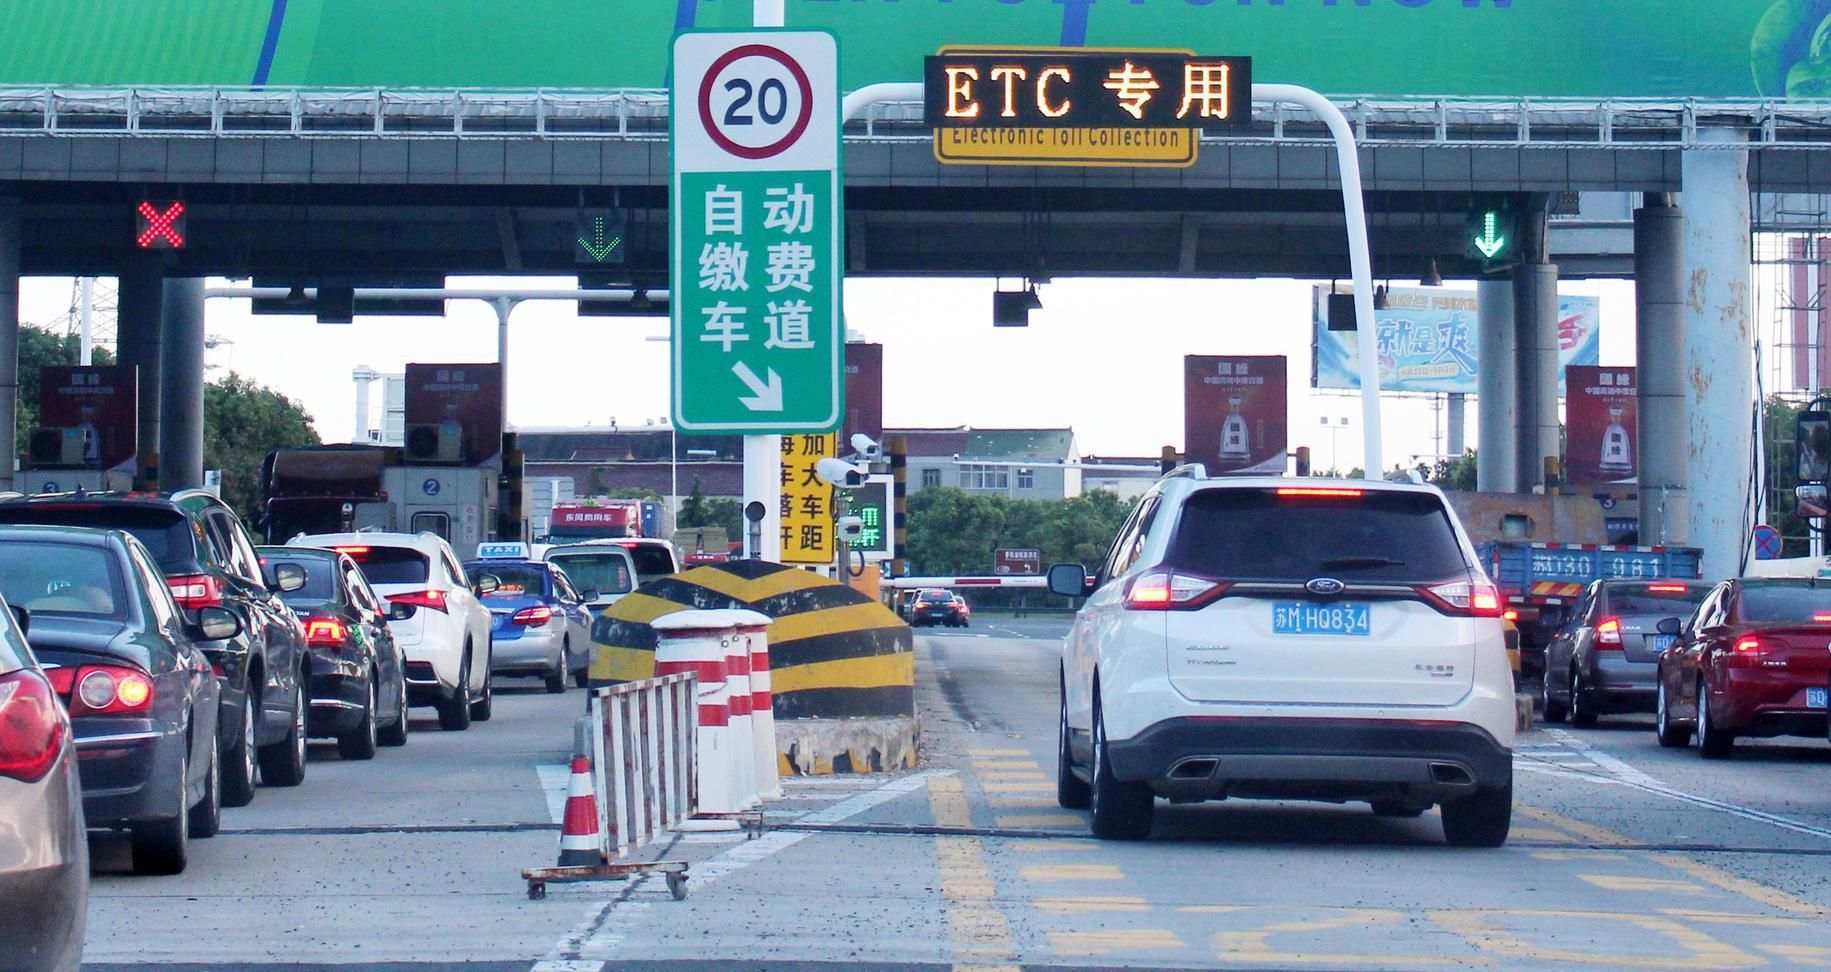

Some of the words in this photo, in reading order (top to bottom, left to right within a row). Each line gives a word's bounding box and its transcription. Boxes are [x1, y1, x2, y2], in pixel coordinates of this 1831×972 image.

[723, 78, 788, 126] 20
[944, 66, 1071, 118] ETC
[1103, 60, 1230, 120] 专用
[1089, 127, 1179, 148] Collection
[704, 182, 815, 236] 自动
[698, 241, 816, 293] 缴费
[700, 299, 816, 353] 车道
[426, 480, 437, 495] 2
[800, 434, 823, 551] 加大车距
[1612, 557, 1660, 580] 981
